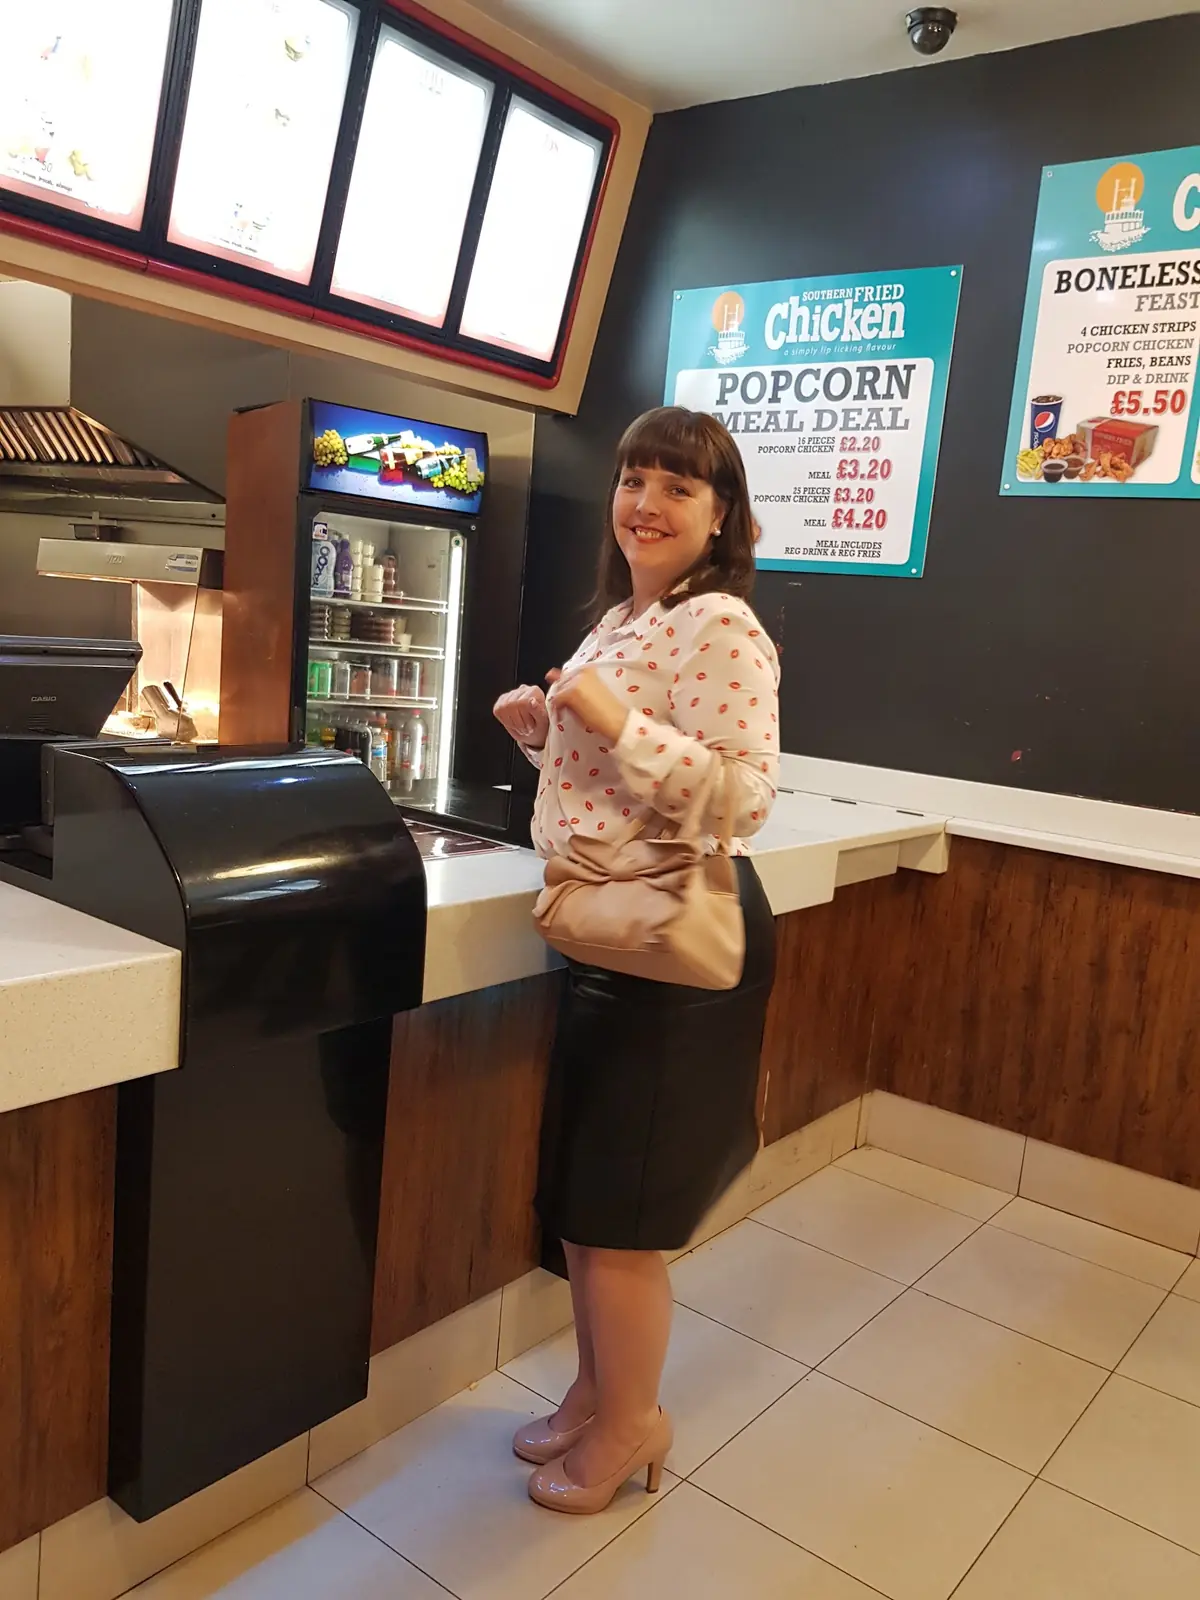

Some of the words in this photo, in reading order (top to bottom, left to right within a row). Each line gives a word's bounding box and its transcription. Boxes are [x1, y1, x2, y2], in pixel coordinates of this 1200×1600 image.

[802, 288, 853, 302] SOUTHERN
[854, 284, 905, 302] FRIED
[1135, 291, 1200, 312] FEAST
[764, 296, 906, 350] Chicken
[1081, 327, 1087, 336] 4
[1090, 323, 1149, 336] CHICKEN
[1152, 321, 1197, 333] STRIPS
[791, 347, 818, 357] simply
[820, 346, 832, 355] lip
[866, 342, 897, 351] flavour
[1067, 341, 1130, 354] POPCORN
[1133, 338, 1194, 351] CHICKEN
[1106, 357, 1146, 369] FRIES,
[1149, 355, 1191, 367] BEANS
[715, 364, 916, 405] POPCORN
[1107, 374, 1130, 385] DIP
[1132, 374, 1142, 384] &
[1145, 372, 1189, 384] DRINK
[1110, 388, 1187, 416] £5.50
[812, 406, 911, 432] DEAL
[807, 436, 836, 445] PIECES
[839, 435, 882, 452] £2.20
[757, 445, 796, 454] POPCORN
[797, 445, 835, 453] CHICKEN
[808, 471, 832, 480] MEAL
[836, 458, 893, 481] £3.20
[753, 494, 792, 503] POPCORN
[793, 495, 830, 503] CHICKEN
[793, 487, 801, 495] 25
[802, 487, 831, 496] PIECES
[833, 487, 875, 504] £3.20
[804, 519, 828, 527] MEAL
[831, 508, 888, 530] £4.20
[784, 547, 801, 556] REG
[802, 548, 829, 557] DRINK
[830, 549, 837, 557] &
[838, 550, 856, 558] REG
[857, 550, 882, 559] FRIES
[815, 540, 839, 549] MEAL
[840, 541, 883, 550] INCLUDES
[312, 545, 331, 586] YAZOO
